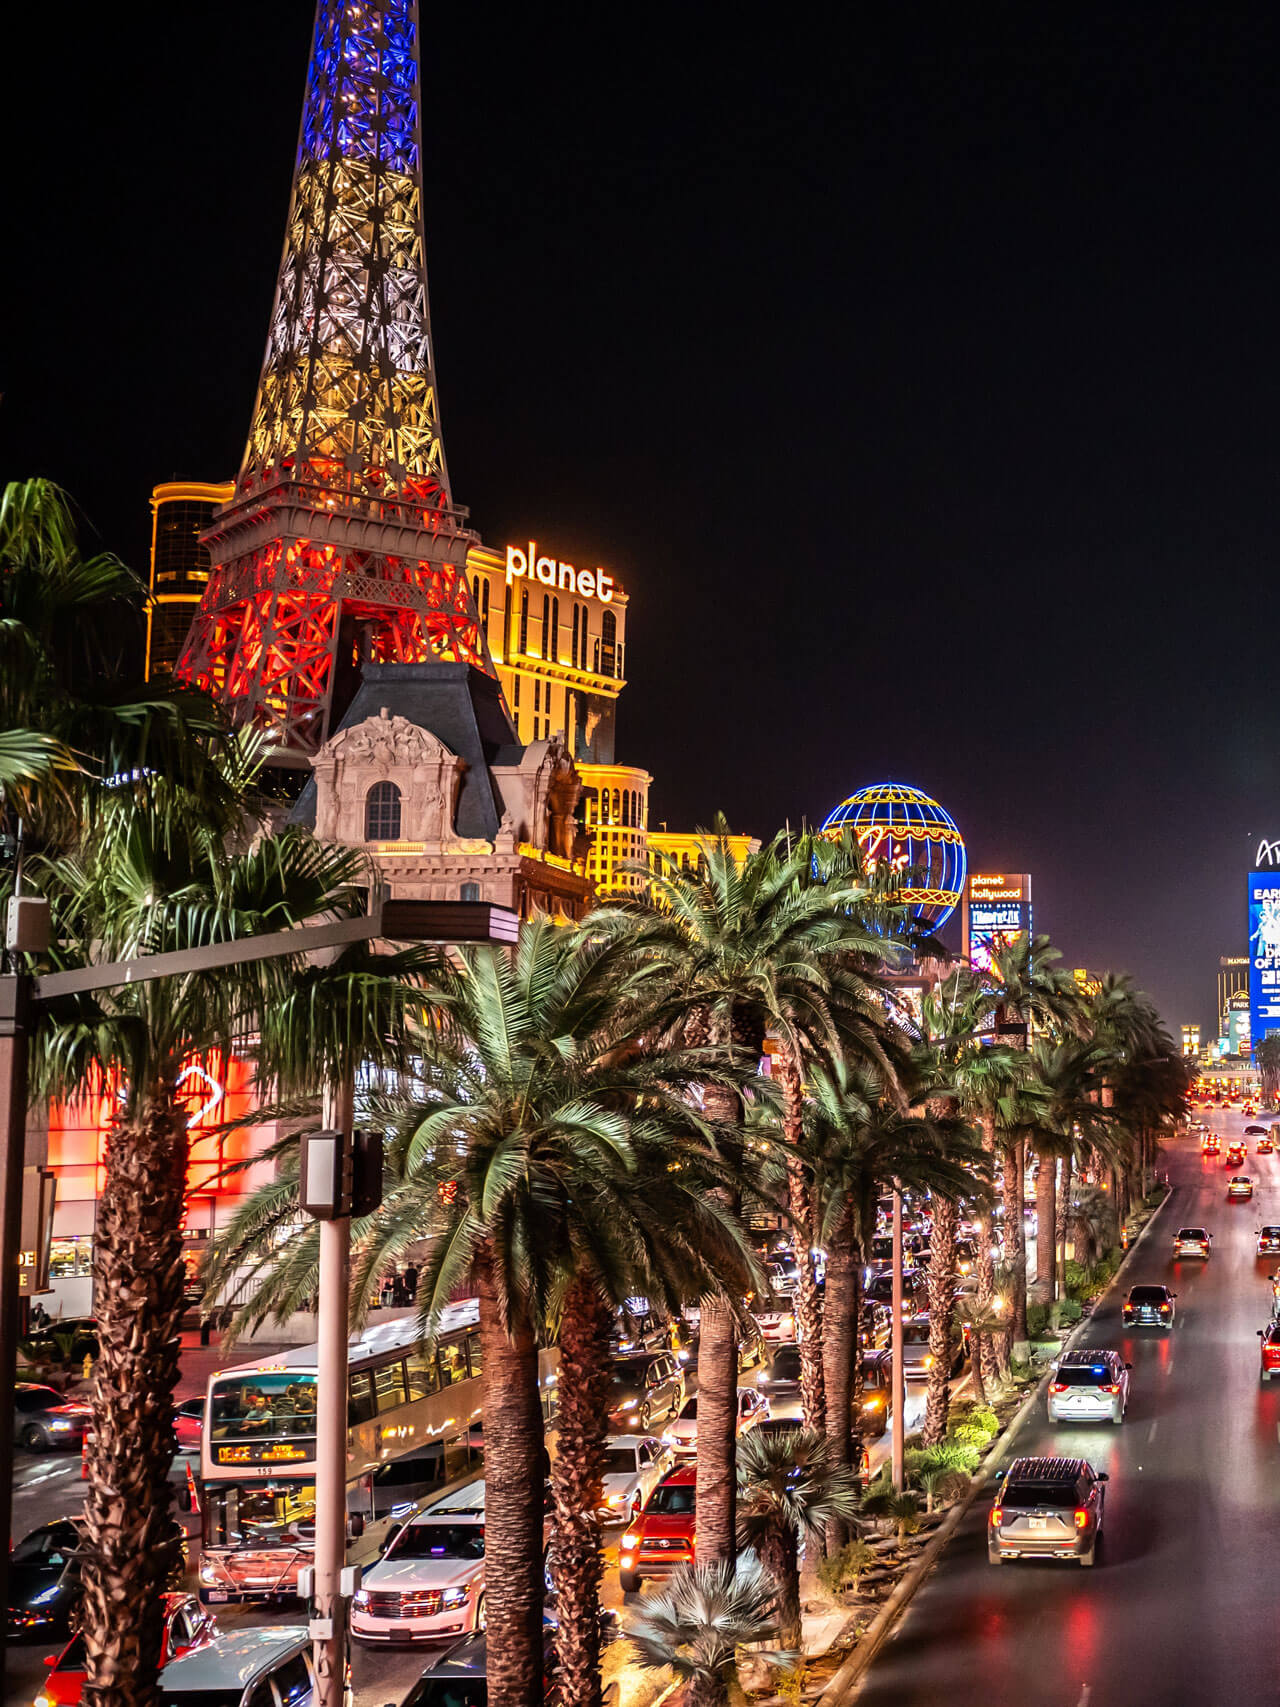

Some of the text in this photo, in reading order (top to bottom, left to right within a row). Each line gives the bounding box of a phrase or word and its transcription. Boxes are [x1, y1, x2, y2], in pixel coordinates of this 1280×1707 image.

[505, 540, 615, 603] planet
[971, 874, 1004, 886] planet
[971, 888, 1021, 901] hollywood
[1254, 957, 1273, 970] OF
[257, 1467, 273, 1475] 159
